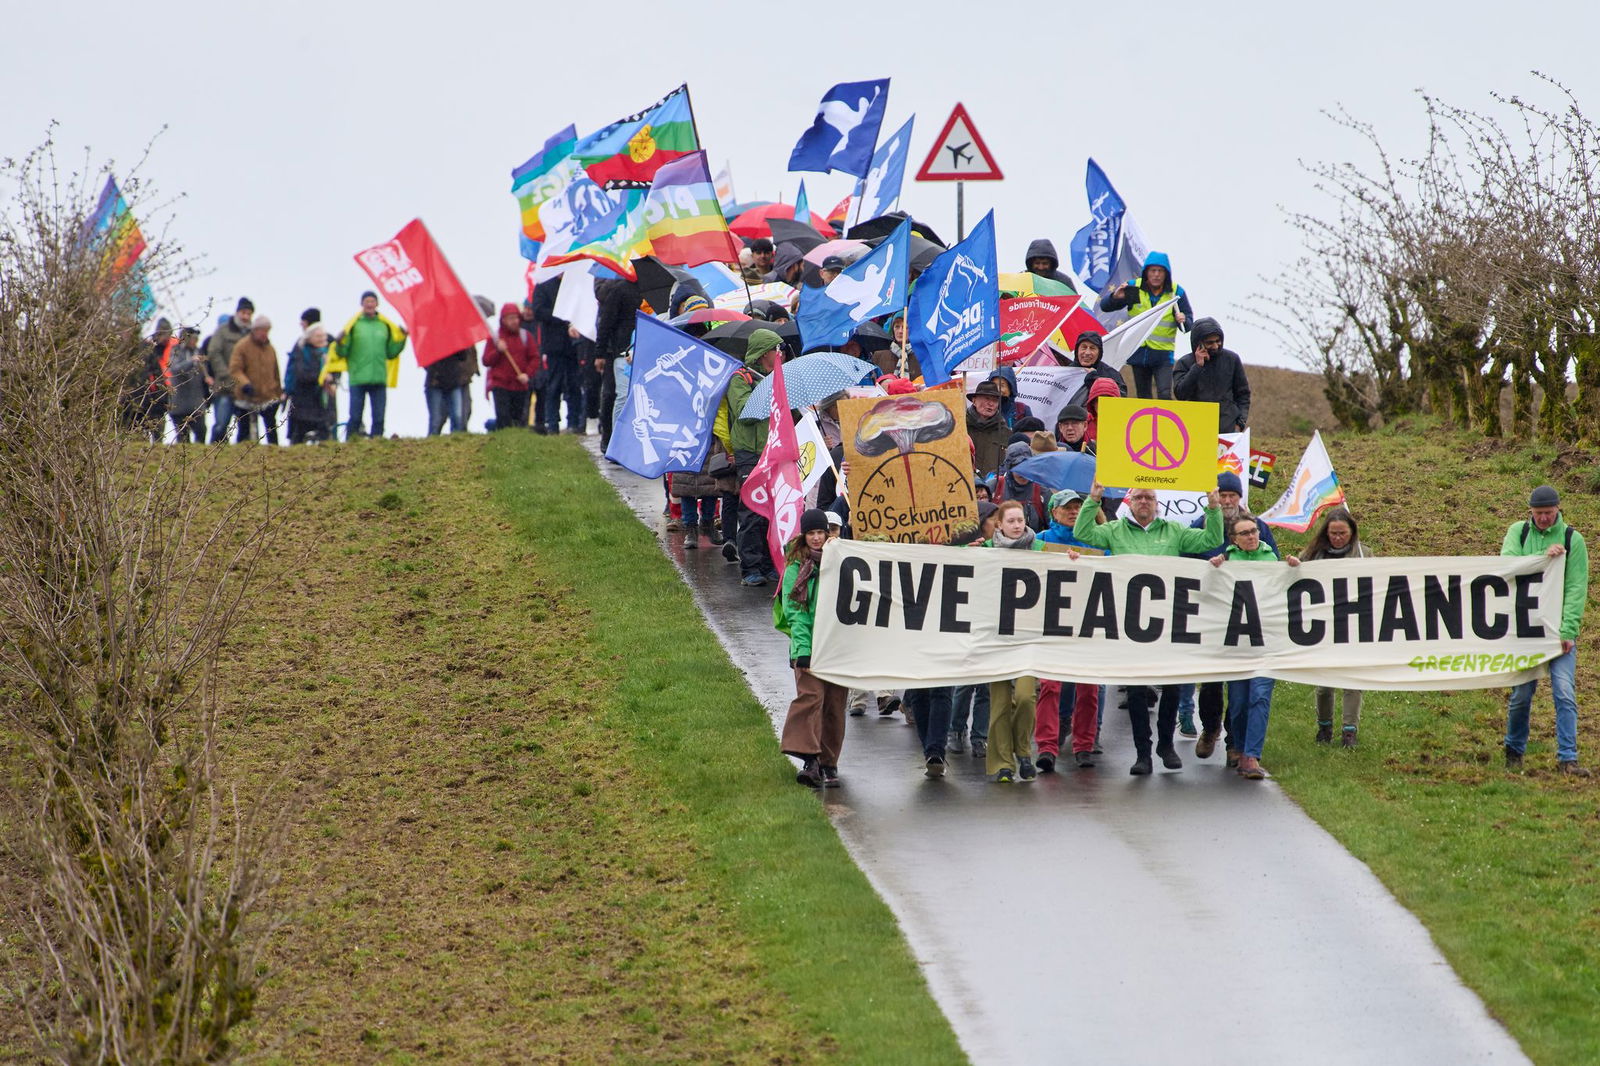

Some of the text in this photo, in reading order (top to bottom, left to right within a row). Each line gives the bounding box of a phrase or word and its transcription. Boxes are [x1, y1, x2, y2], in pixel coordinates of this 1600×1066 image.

[1031, 377, 1069, 392] Deutschland
[883, 477, 895, 488] 11
[1135, 475, 1178, 484] GREENPEACE
[947, 483, 955, 493] 2
[857, 501, 966, 532] 90 Sekunden
[835, 556, 1545, 647] GIVE PEACE A CHANCE
[1408, 652, 1546, 674] GREENPEACE
